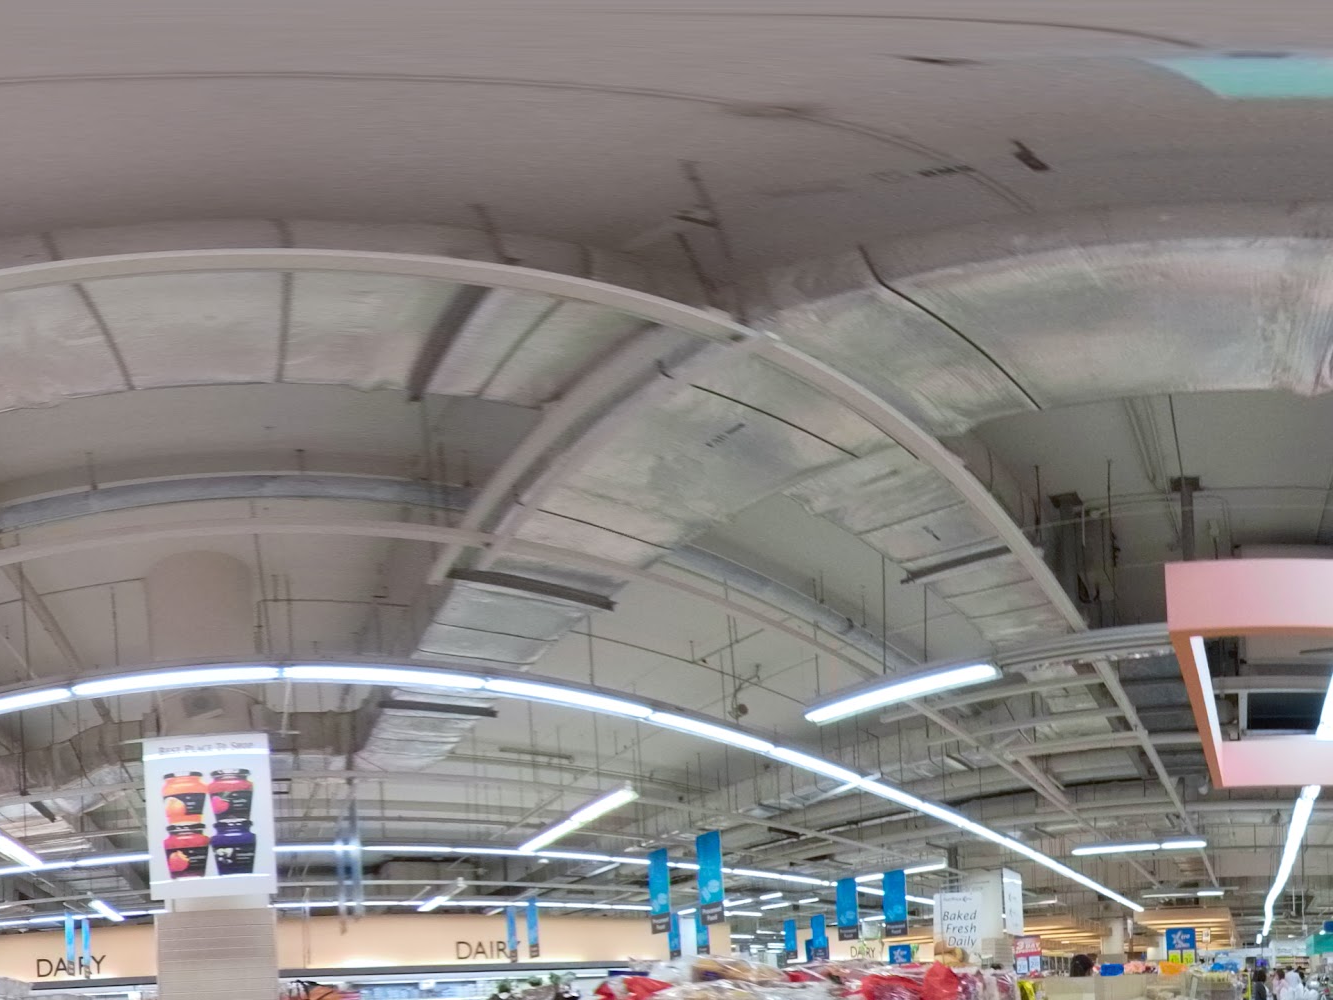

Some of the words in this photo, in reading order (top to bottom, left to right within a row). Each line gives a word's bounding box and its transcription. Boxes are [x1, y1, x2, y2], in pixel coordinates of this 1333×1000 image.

[942, 909, 978, 921] Baked
[946, 924, 978, 934] Fresh
[947, 935, 978, 948] Daily
[456, 941, 521, 960] DAIR
[850, 946, 876, 959] DARY
